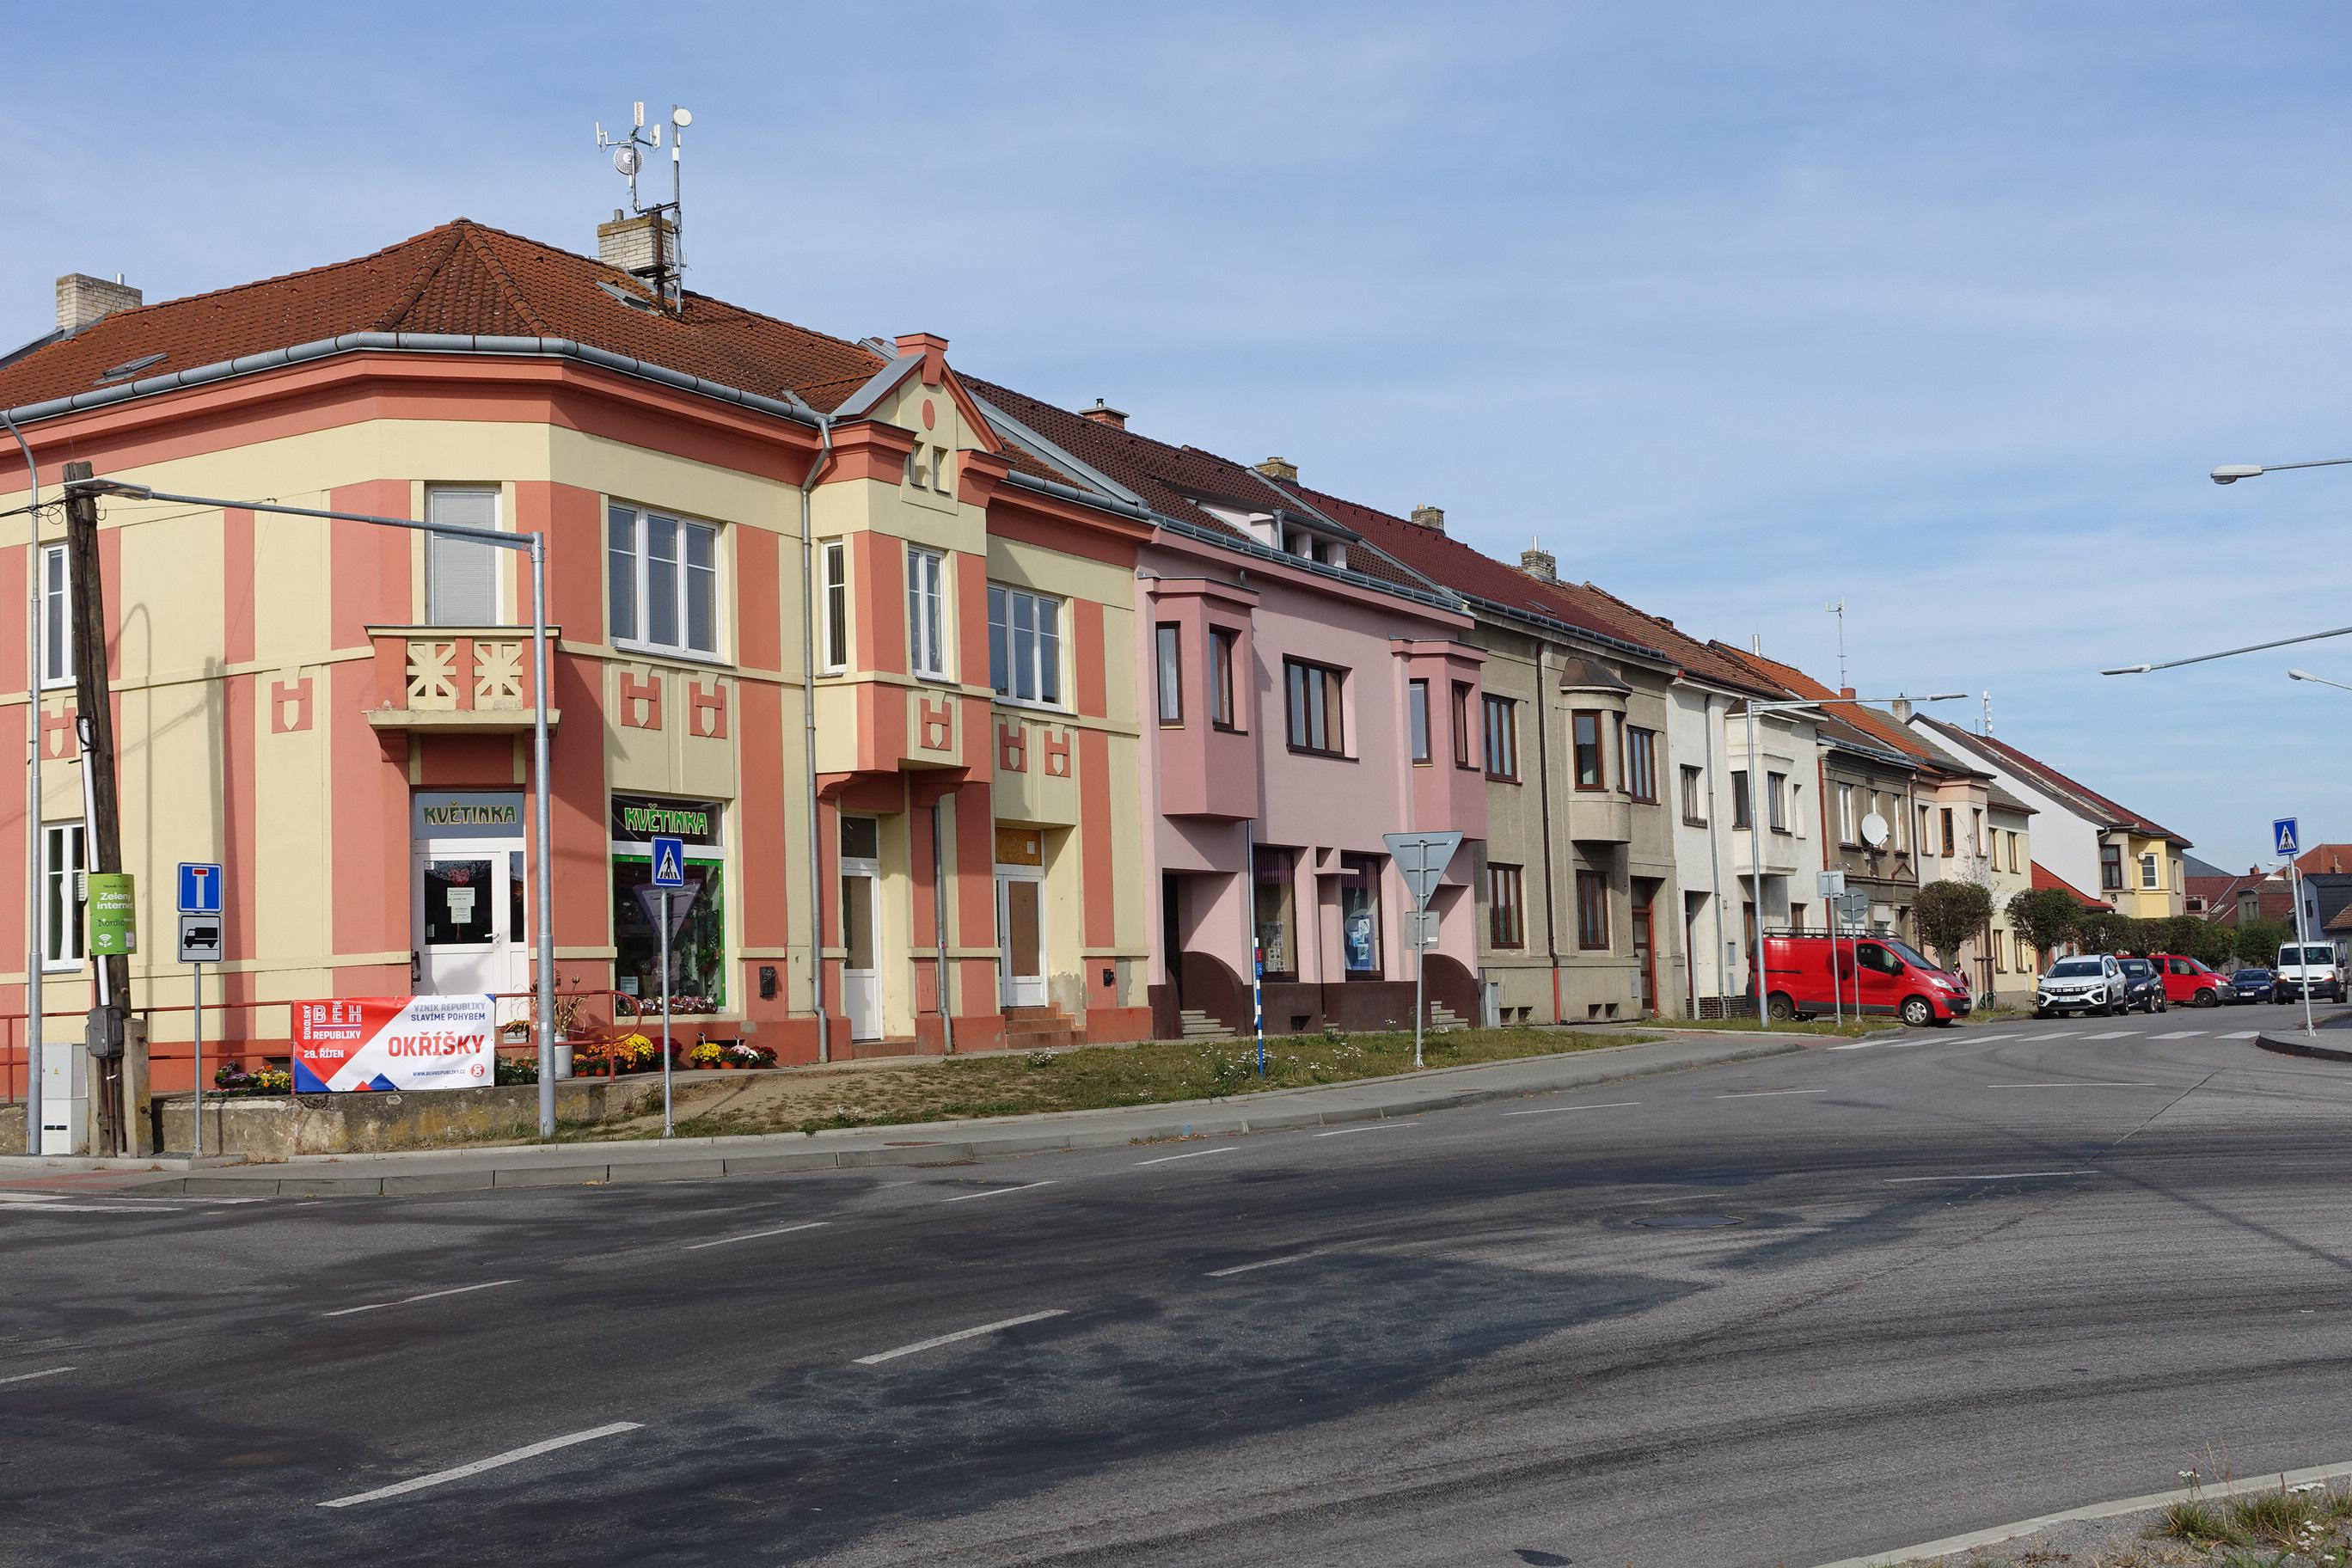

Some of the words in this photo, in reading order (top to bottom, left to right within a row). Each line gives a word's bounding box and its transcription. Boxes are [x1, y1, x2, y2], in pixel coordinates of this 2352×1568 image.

[423, 800, 517, 824] KVĚTINKA
[624, 803, 708, 835] KVĚTINKA
[441, 1002, 486, 1011] REPUBLIKY
[303, 1005, 311, 1039] SOKOLSKÝ
[411, 1013, 445, 1021] SLAVÍME
[313, 1031, 361, 1039] REPUBLIKY
[388, 1031, 485, 1057] OKŘÍŠKY
[303, 1050, 318, 1058] 28.
[320, 1048, 344, 1058] ŘÍJEN
